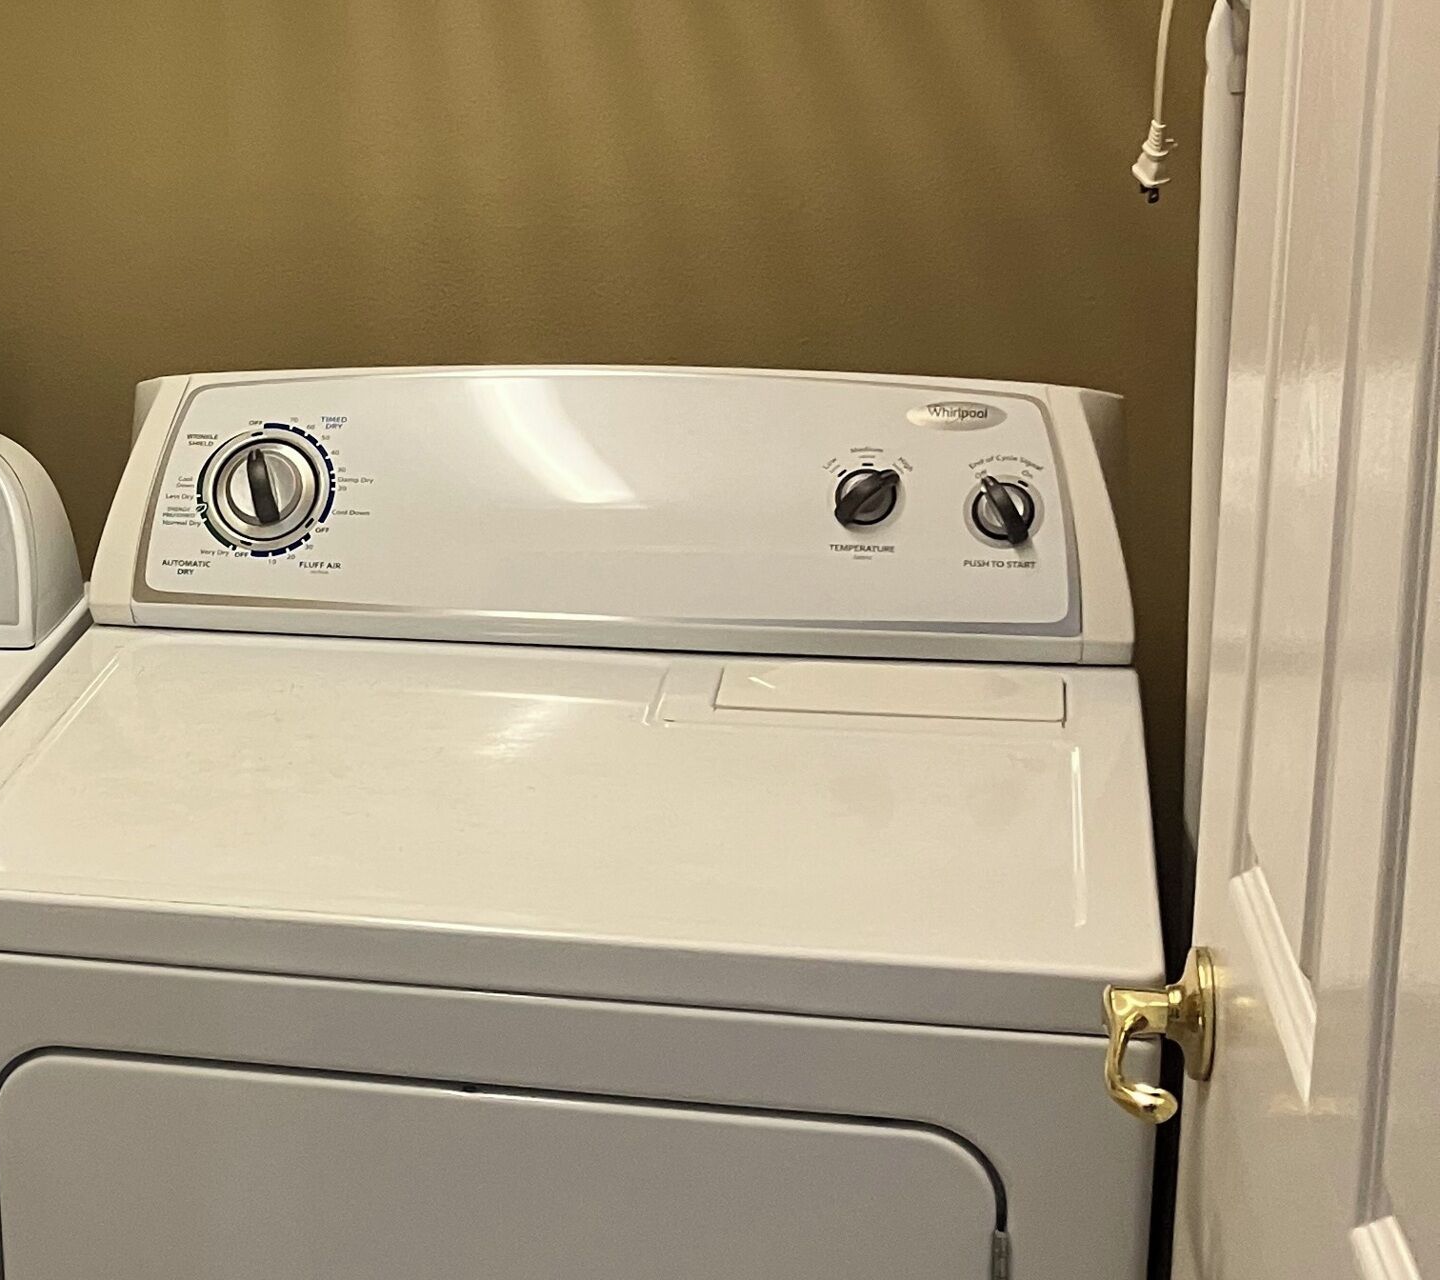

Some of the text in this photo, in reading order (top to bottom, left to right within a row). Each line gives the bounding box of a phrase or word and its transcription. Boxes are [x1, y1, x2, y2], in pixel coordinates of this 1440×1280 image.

[927, 404, 989, 420] Whirlpool
[321, 416, 348, 424] TIMED
[325, 423, 343, 431] DRY
[829, 544, 895, 553] TEMPERATURE
[162, 560, 212, 568] AUTOMATIC
[299, 561, 342, 570] FLUFF AIR
[963, 559, 1036, 570] PUSH TO START
[177, 568, 194, 576] DRY
